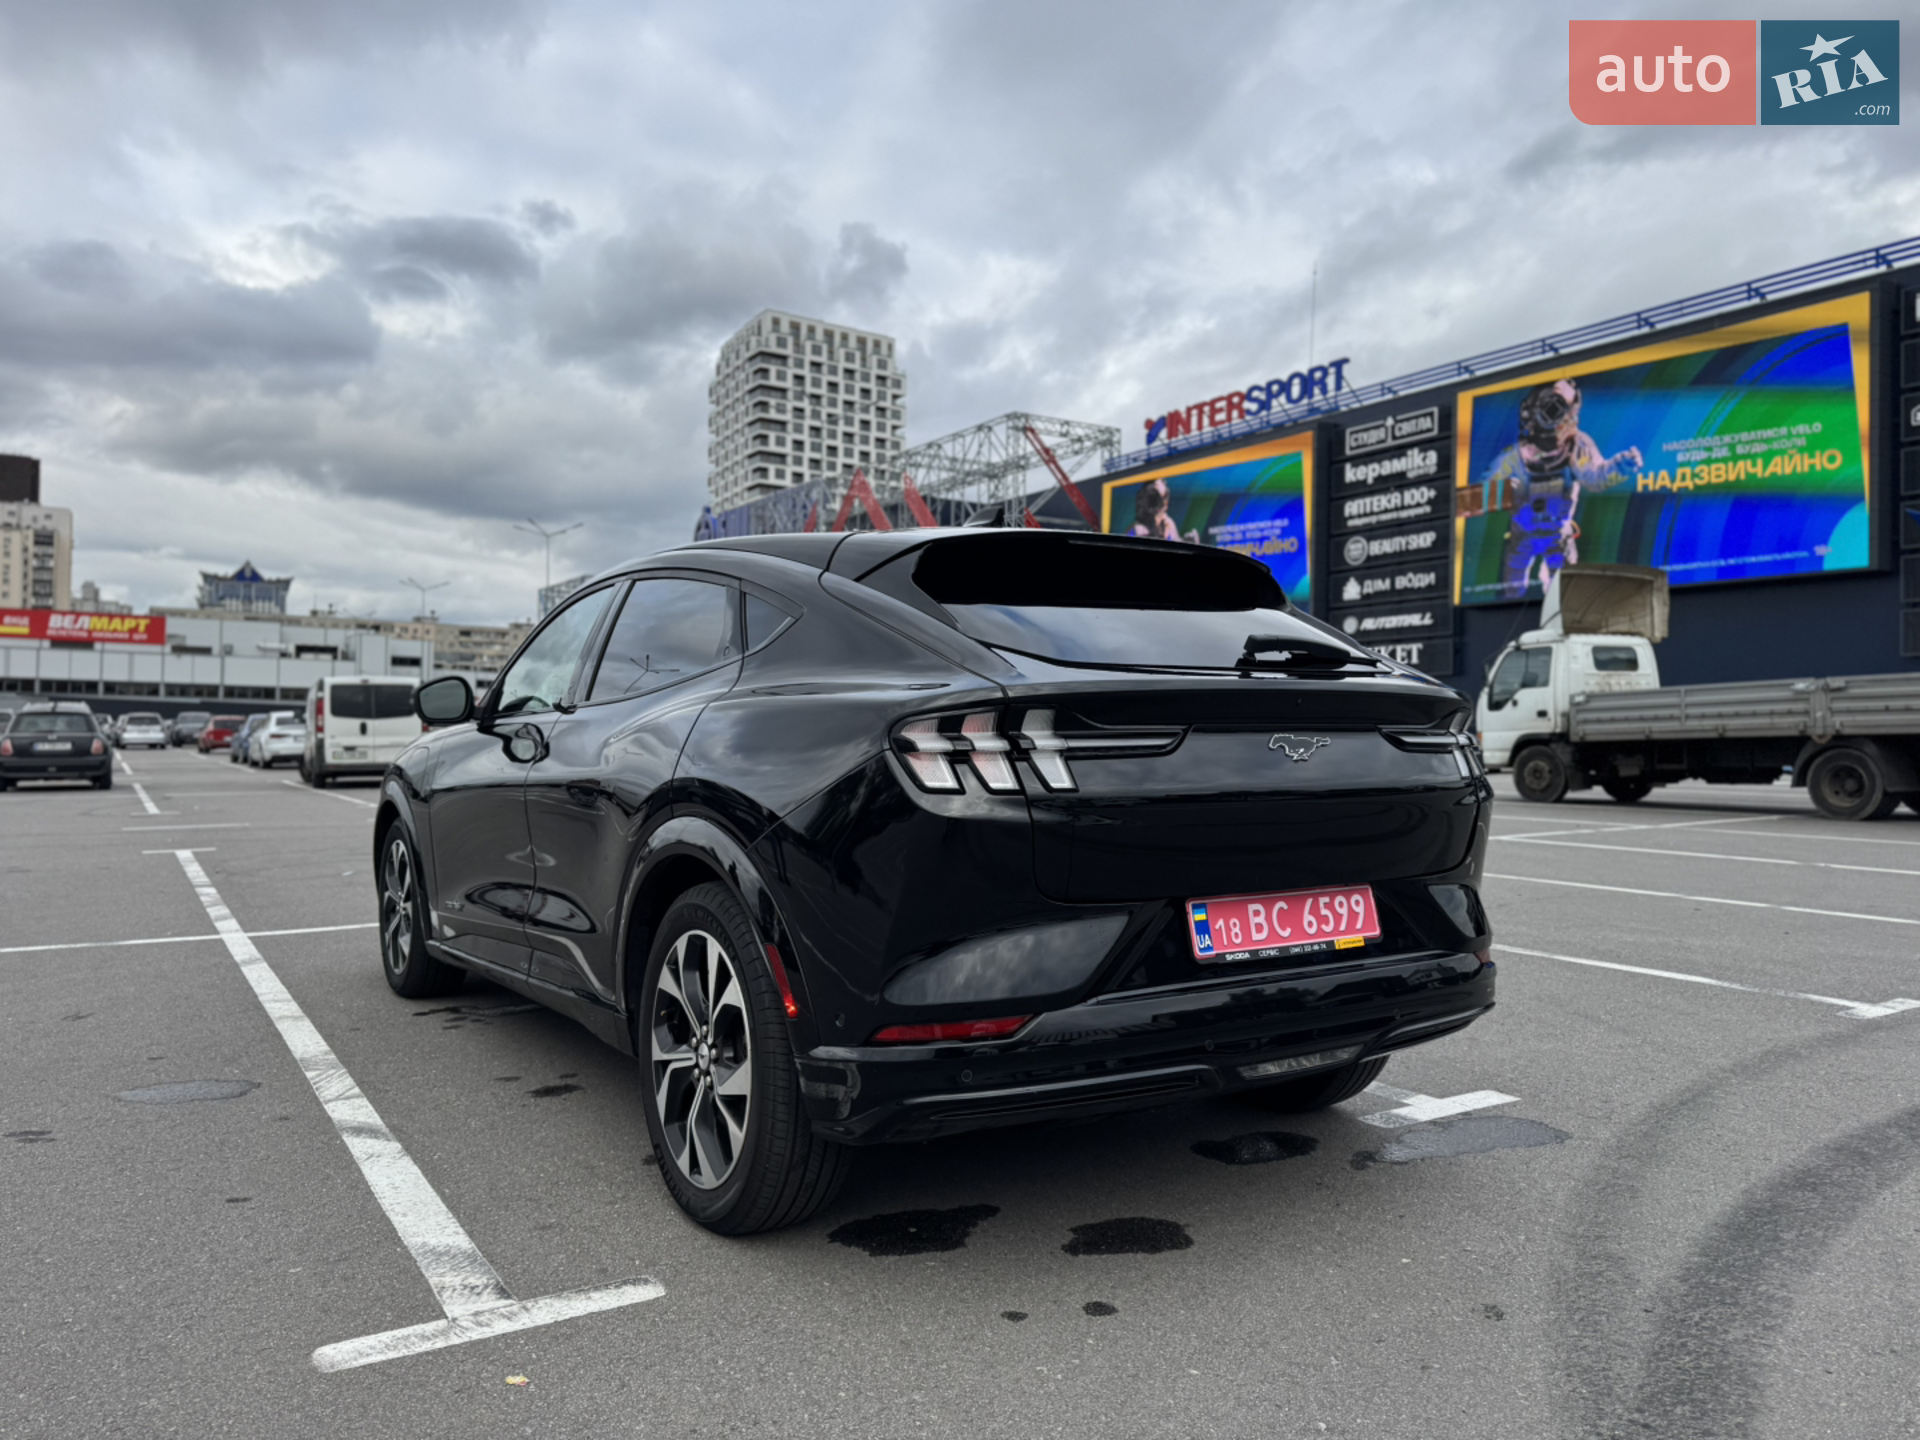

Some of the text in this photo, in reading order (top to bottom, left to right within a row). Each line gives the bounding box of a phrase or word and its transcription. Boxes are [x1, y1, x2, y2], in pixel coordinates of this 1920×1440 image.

[1167, 357, 1350, 440] INTERSPORT
[1636, 448, 1843, 493] НАДЗВИЧАЙНО
[1344, 491, 1402, 518] АПТЕКА
[1362, 577, 1391, 595] ДІМ
[48, 613, 150, 633] ВЕЛМАРТ
[1215, 894, 1366, 946] 18 BC 6599
[1197, 934, 1212, 949] UA
